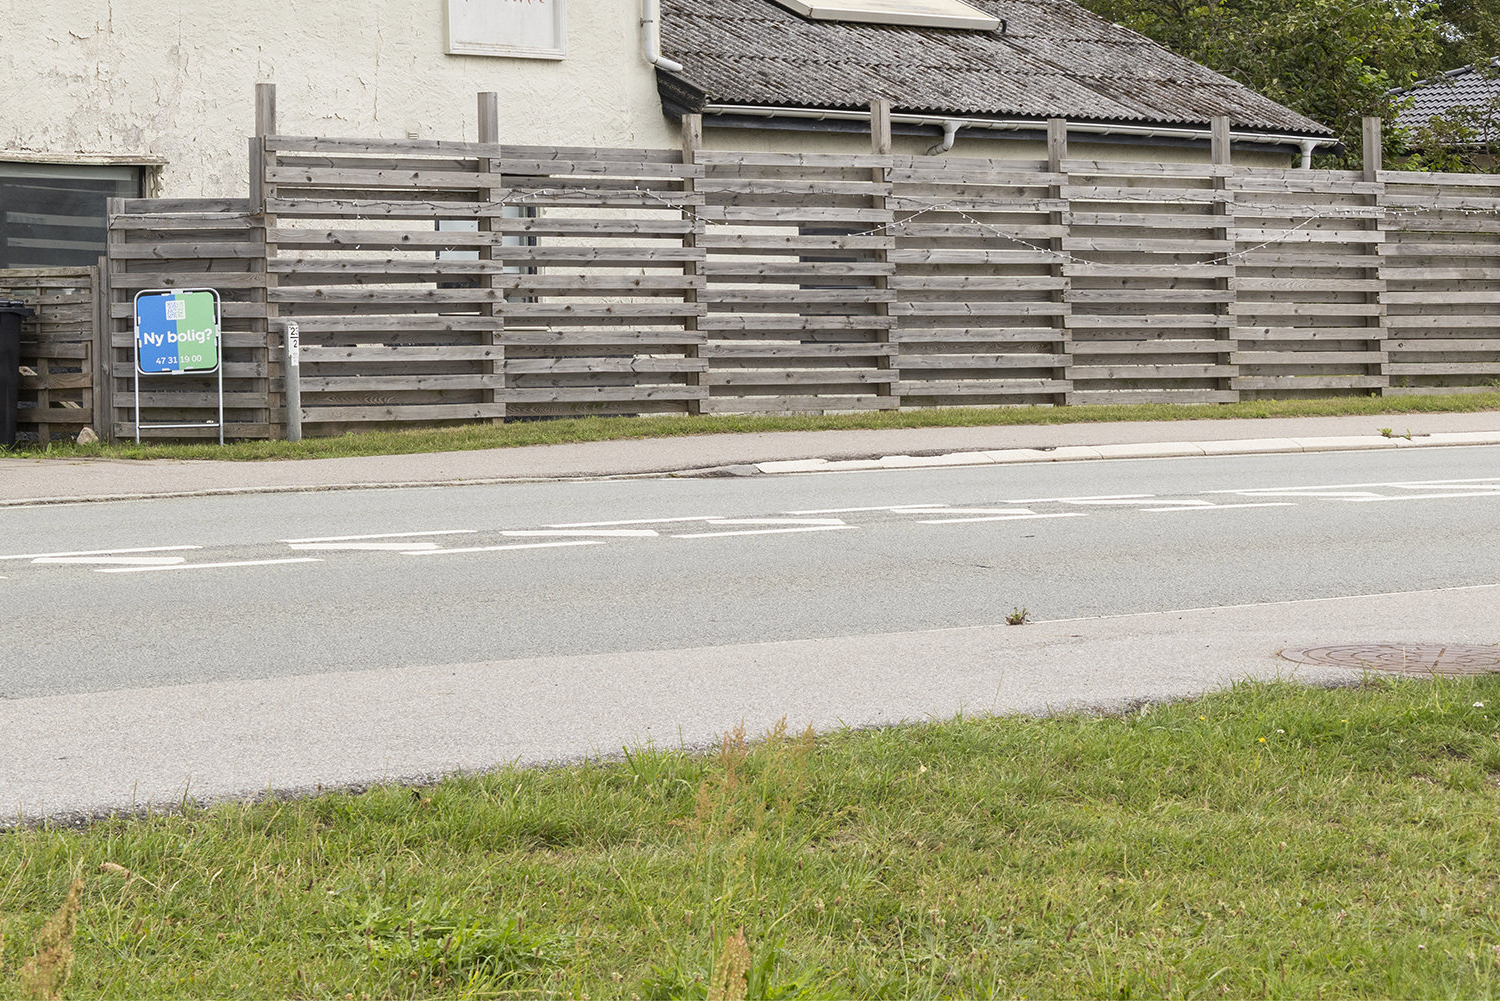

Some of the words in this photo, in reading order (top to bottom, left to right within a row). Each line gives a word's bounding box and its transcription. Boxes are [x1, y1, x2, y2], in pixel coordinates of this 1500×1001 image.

[143, 331, 164, 347] Ny
[167, 328, 213, 344] bolig?
[293, 339, 298, 348] 2
[155, 357, 166, 365] 47
[168, 356, 178, 364] 31
[180, 355, 190, 364] 19
[191, 354, 202, 362] 00
